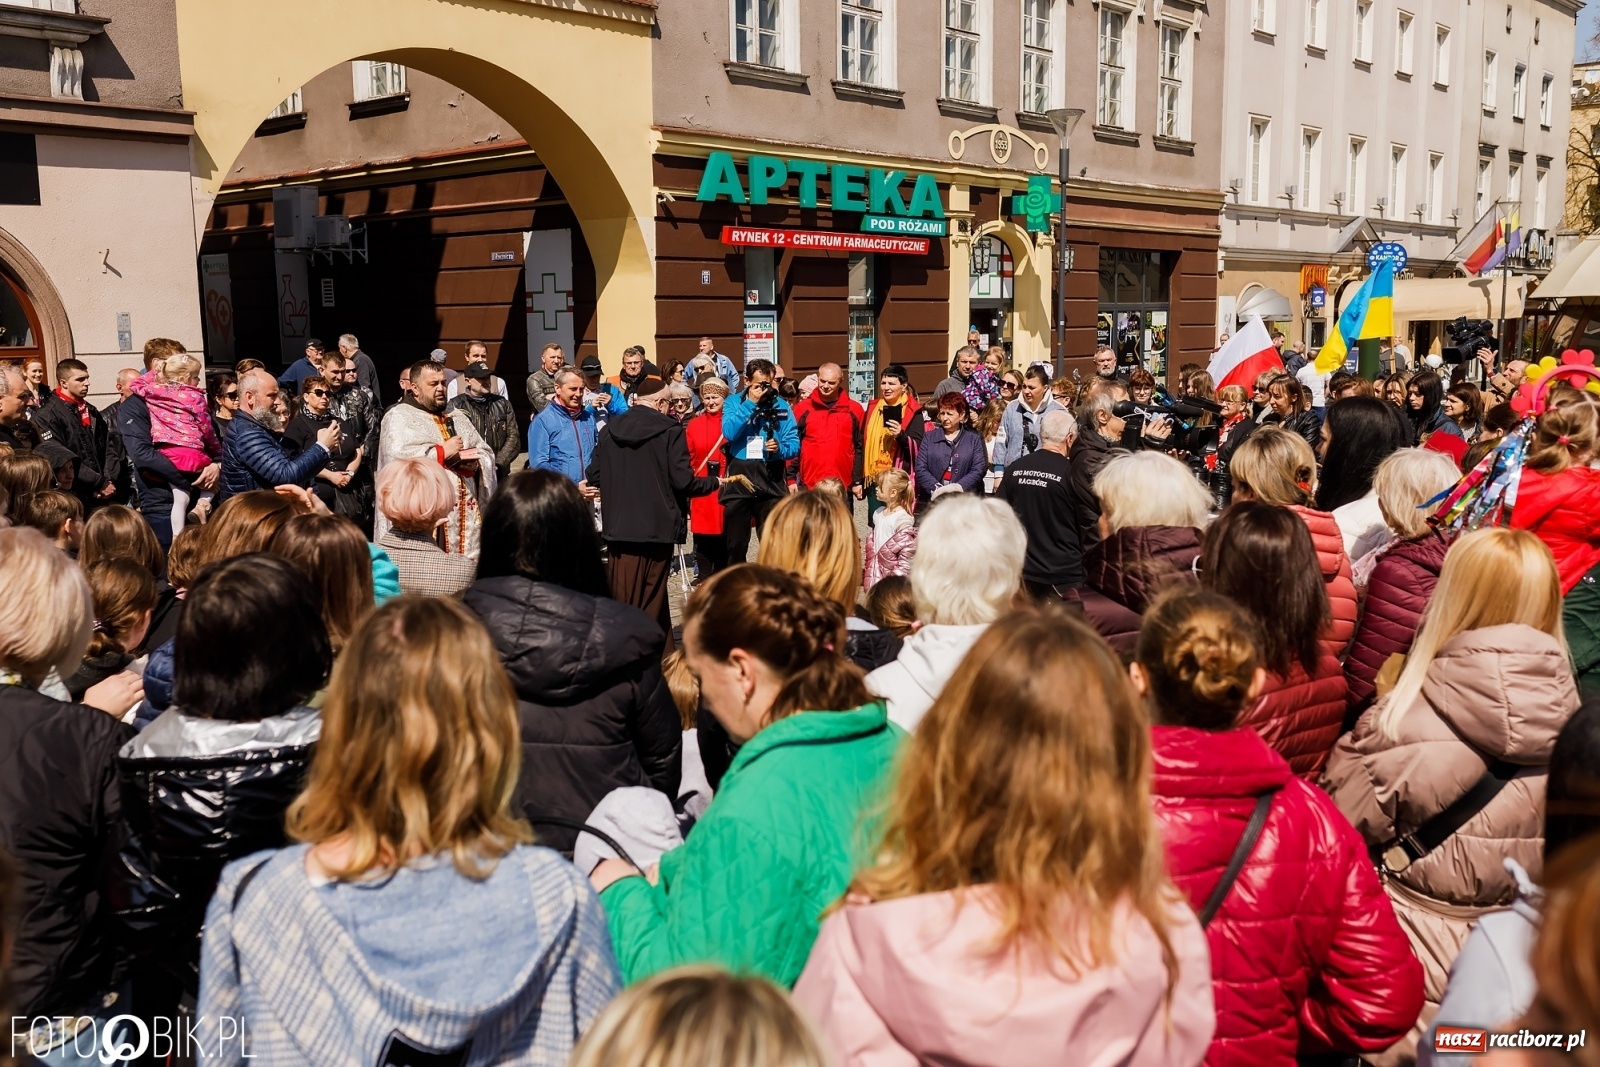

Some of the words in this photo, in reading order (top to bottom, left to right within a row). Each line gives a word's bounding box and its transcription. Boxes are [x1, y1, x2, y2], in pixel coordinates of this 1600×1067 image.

[696, 151, 946, 219] APTEKA
[870, 218, 895, 230] POD
[898, 219, 942, 234] RÓŻAMI
[731, 230, 770, 244] RYNEK
[772, 233, 785, 244] 12
[793, 234, 842, 248] CENTRUM
[843, 236, 926, 252] FARMACEUTYCZNE
[1018, 478, 1048, 488] RACIBÓRZ
[1023, 469, 1062, 482] MOTOCYKLE
